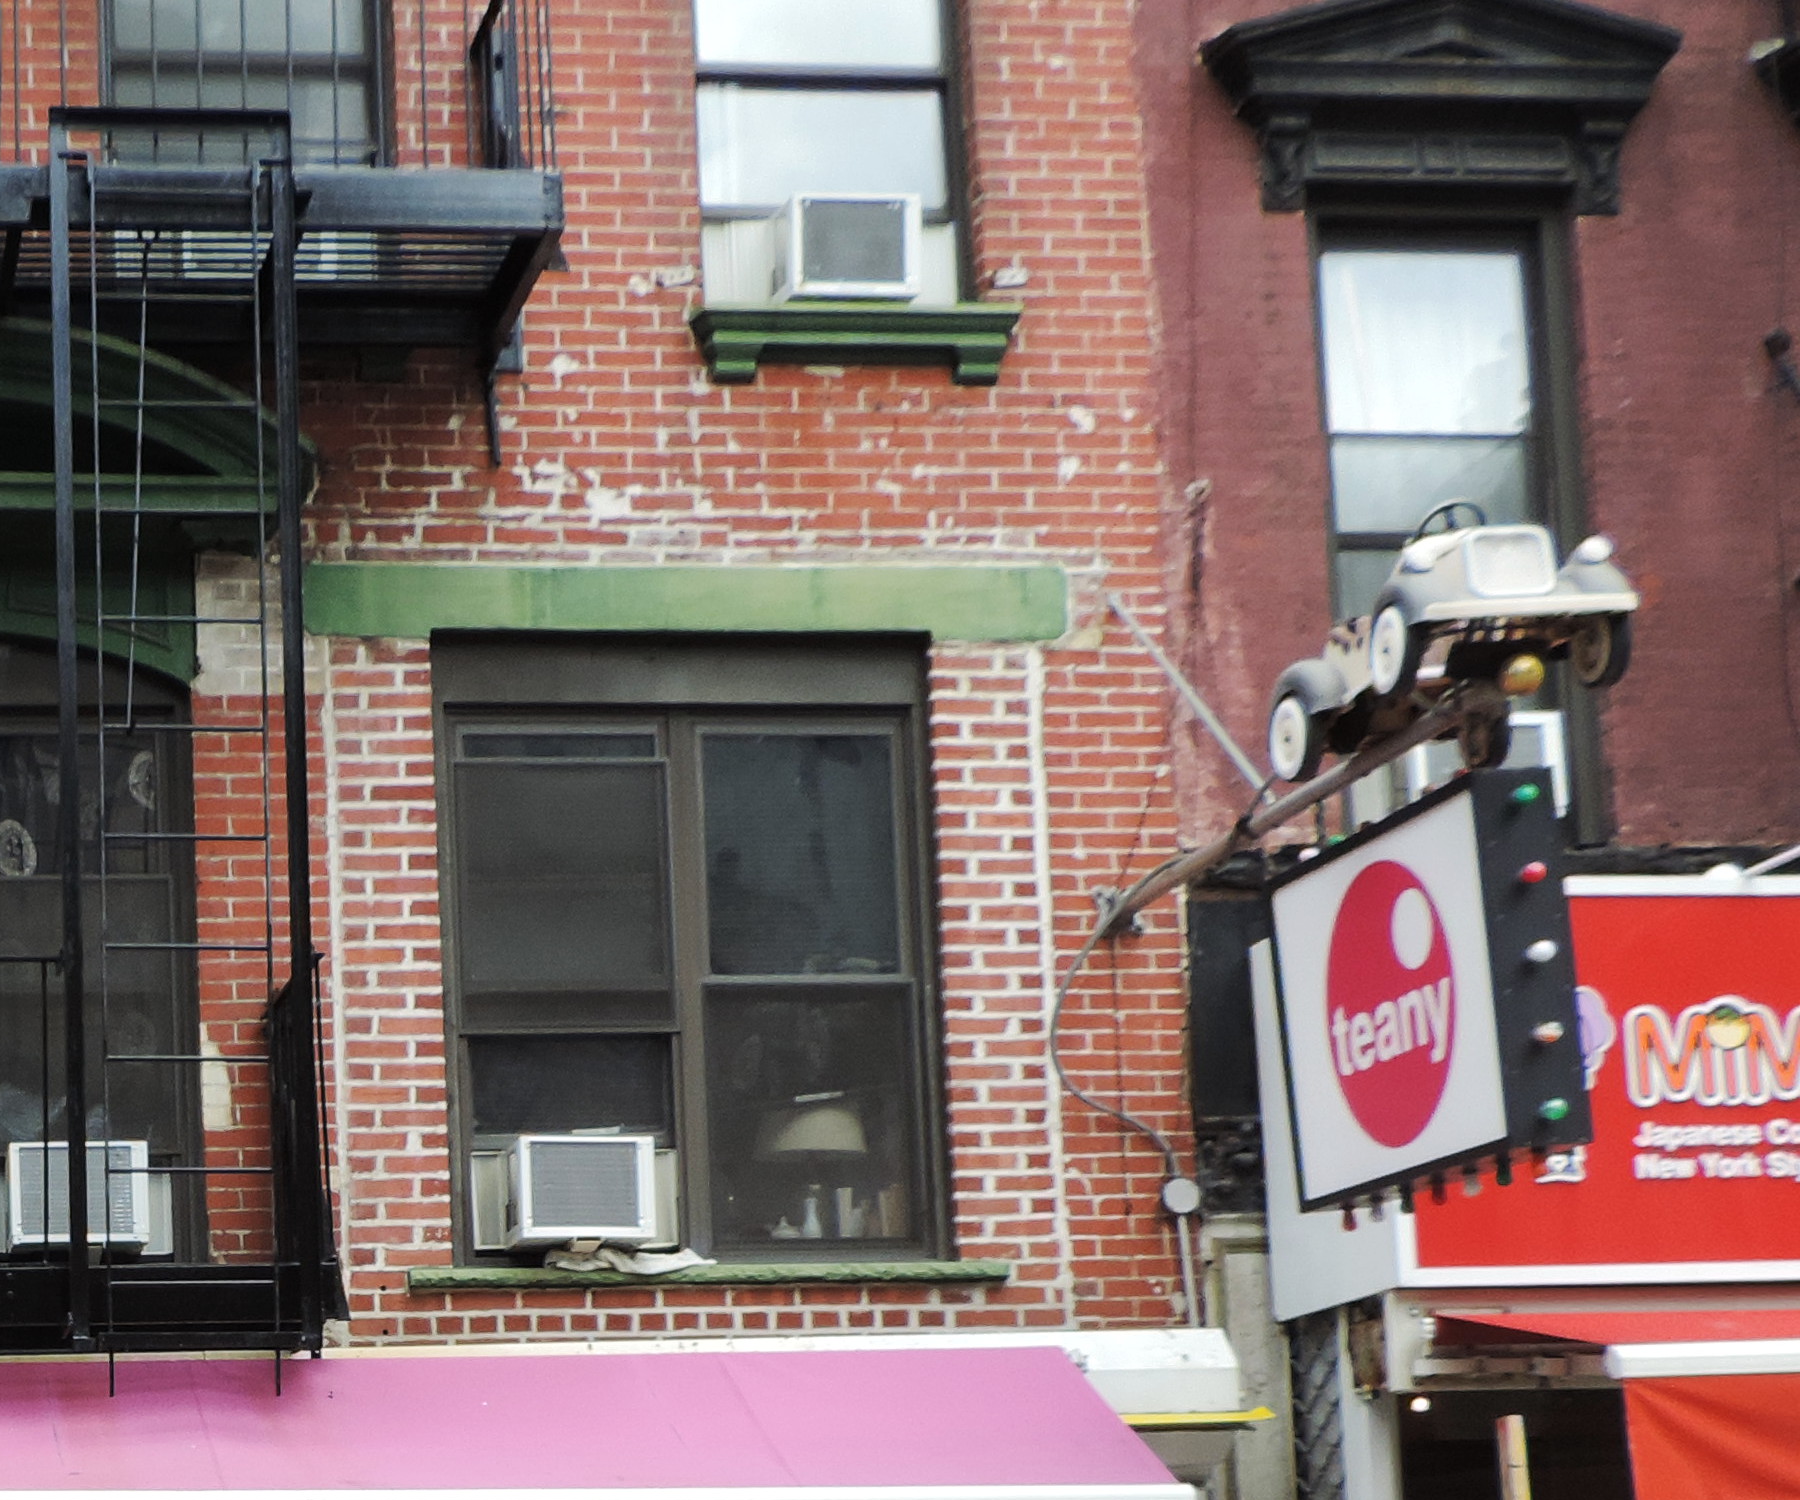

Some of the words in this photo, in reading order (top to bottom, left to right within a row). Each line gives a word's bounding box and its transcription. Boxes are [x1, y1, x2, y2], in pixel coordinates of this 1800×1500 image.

[1331, 976, 1451, 1077] teany
[1633, 1122, 1762, 1151] Japanese
[1634, 1153, 1697, 1179] New
[1698, 1151, 1762, 1178] York
